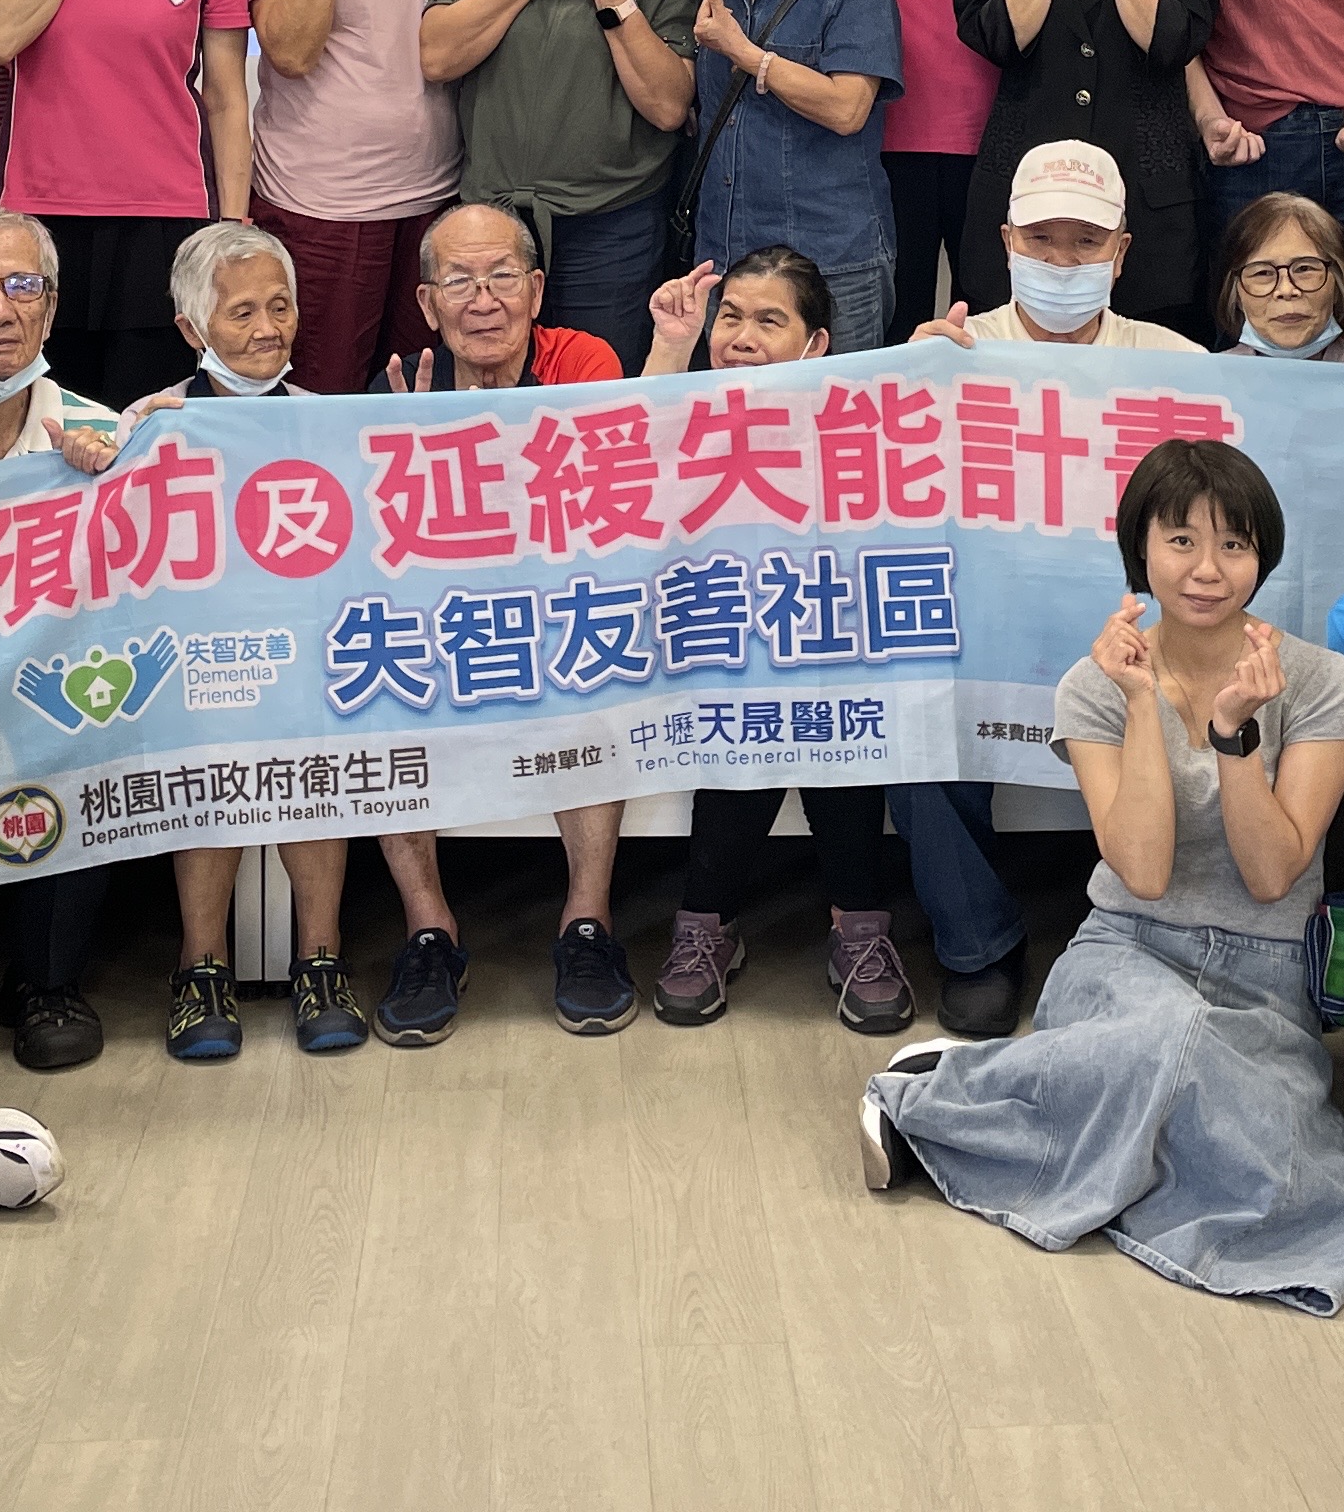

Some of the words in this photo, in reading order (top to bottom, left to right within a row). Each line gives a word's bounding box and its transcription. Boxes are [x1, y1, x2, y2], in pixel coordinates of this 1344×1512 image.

[330, 548, 959, 705] 失智友善社區
[185, 633, 292, 666] 失智友善
[187, 664, 274, 686] Dementia
[189, 685, 256, 706] Friends
[630, 697, 886, 753] 中壢天晟醫院
[636, 750, 720, 773] Ten-Chan
[726, 747, 802, 765] General
[810, 743, 889, 764] Hospital
[79, 745, 430, 827] 桃園市政府衛生局
[81, 811, 190, 848] Department
[194, 809, 211, 828] of
[214, 806, 272, 826] Public
[278, 799, 344, 822] Health,
[350, 795, 430, 817] Taoyuan
